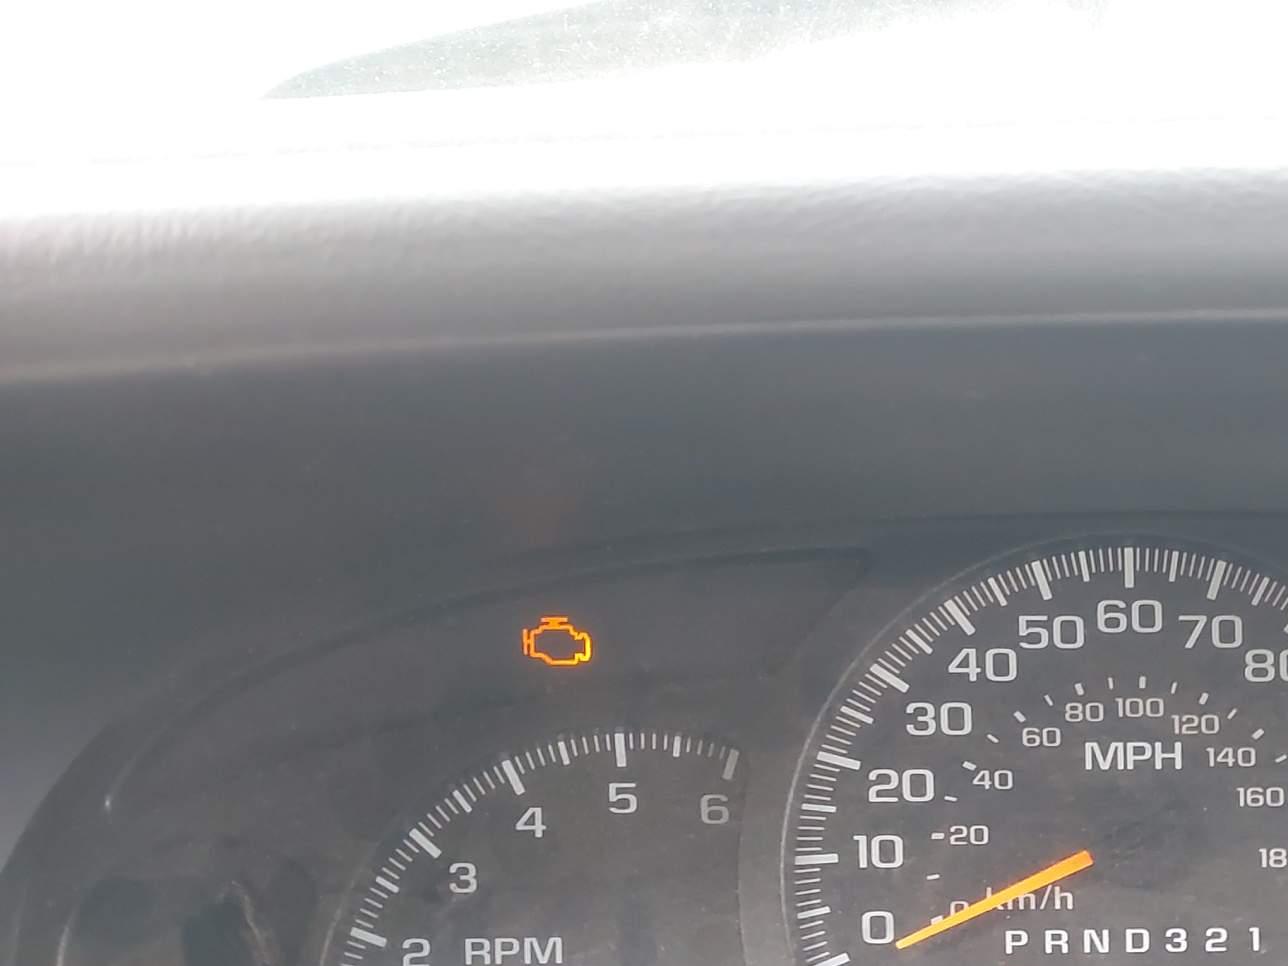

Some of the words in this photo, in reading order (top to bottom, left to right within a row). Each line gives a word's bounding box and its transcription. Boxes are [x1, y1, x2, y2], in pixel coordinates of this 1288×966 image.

[1097, 600, 1163, 633] 60
[1018, 615, 1085, 649] 50
[1178, 615, 1243, 649] 70
[948, 648, 1018, 682] 40
[905, 702, 972, 736] 30
[1065, 703, 1104, 723] 80
[1115, 698, 1164, 718] 100
[1022, 727, 1061, 747] 60
[1171, 715, 1220, 735] 120
[1084, 742, 1182, 770] MPH
[1206, 747, 1256, 767] 140
[868, 769, 935, 803] 20
[972, 770, 1014, 790] 40
[608, 782, 637, 814] 5
[700, 793, 729, 824] 6
[1237, 786, 1285, 807] 160
[515, 807, 547, 838] 4
[949, 825, 989, 845] 20
[853, 835, 904, 869] 10
[449, 863, 477, 893] 3
[861, 911, 894, 945] 0
[465, 937, 563, 965] RPM
